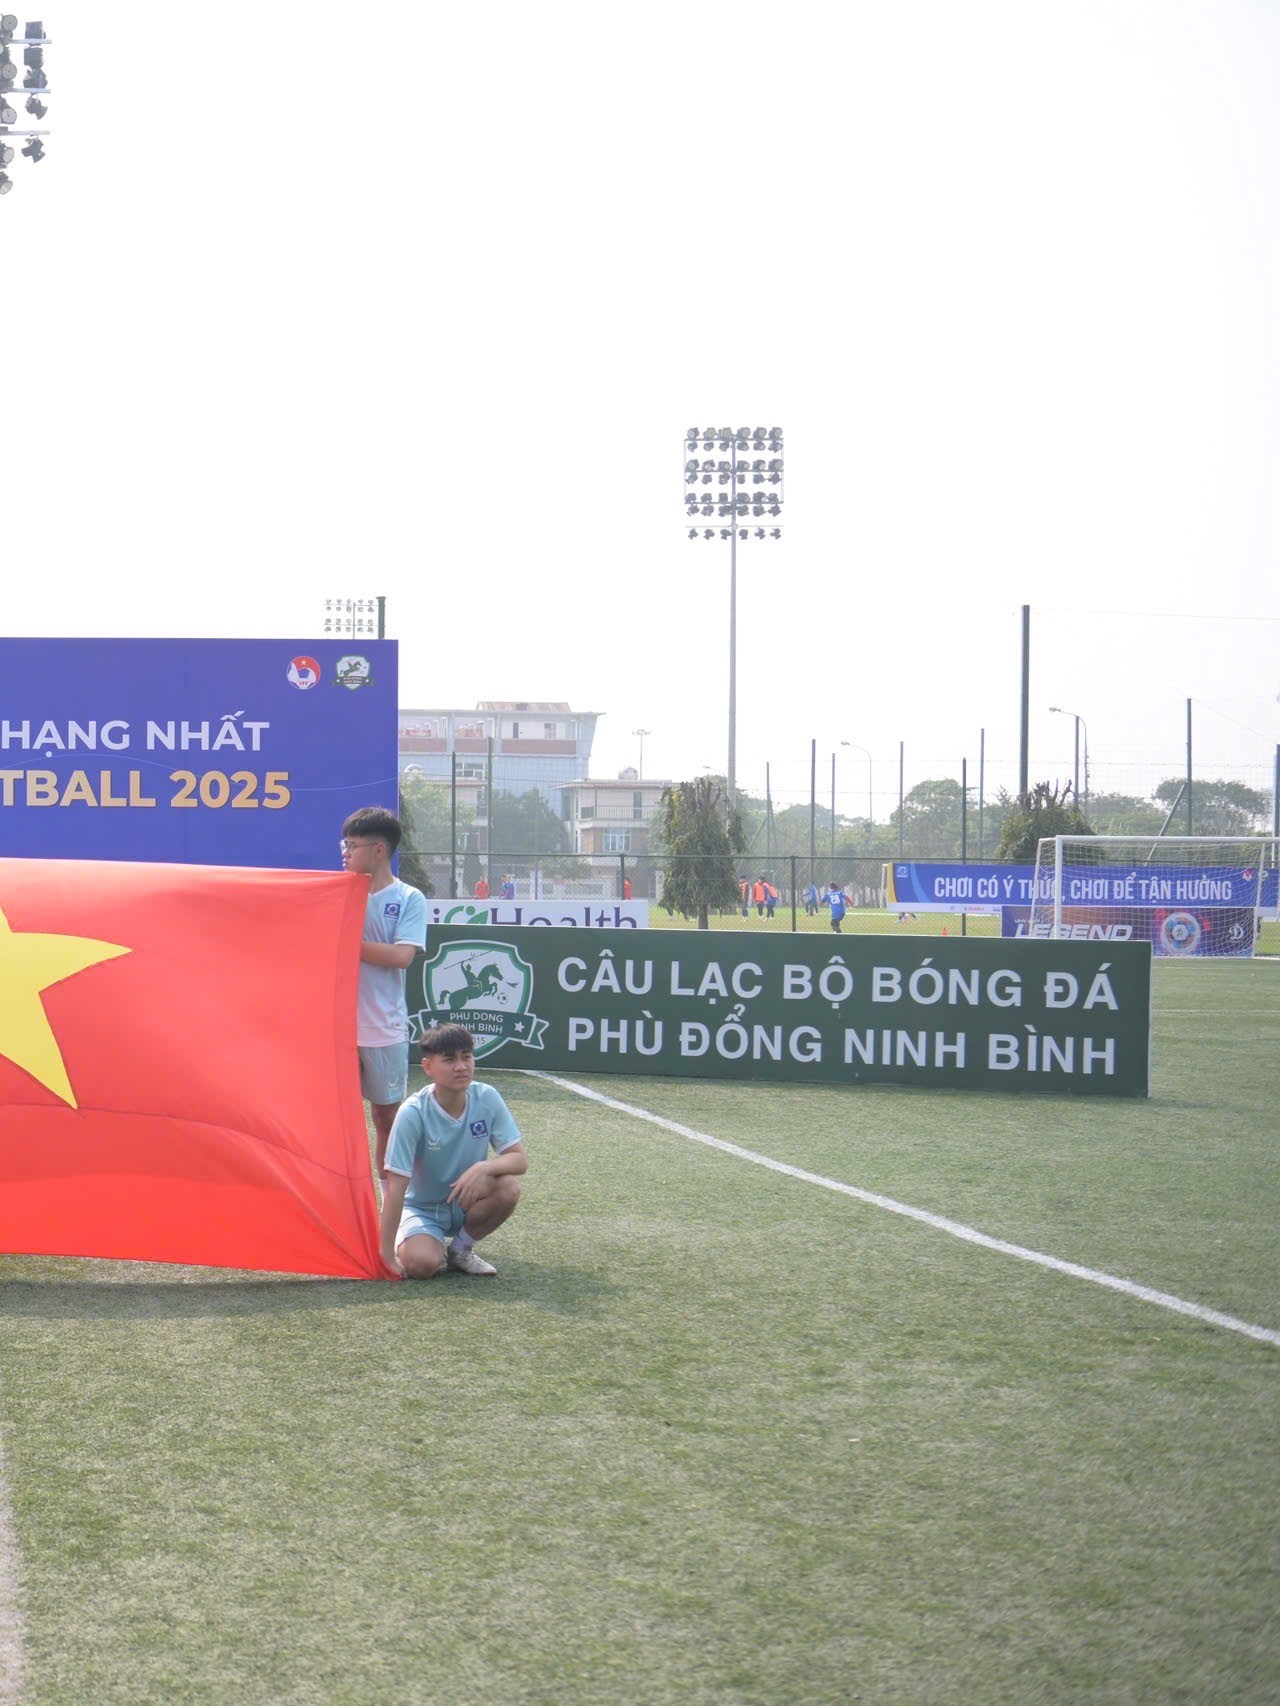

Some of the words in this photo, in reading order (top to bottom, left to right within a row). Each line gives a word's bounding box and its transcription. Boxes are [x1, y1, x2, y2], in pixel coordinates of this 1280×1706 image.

[1, 720, 130, 758] HẠNG
[146, 710, 270, 751] NHẤT
[169, 769, 291, 809] 2025
[934, 876, 973, 898] CHƠI
[977, 874, 998, 899] CÓ
[1000, 874, 1014, 899] Ý
[1070, 879, 1109, 900] CHƠI
[1112, 872, 1136, 900] ĐỂ
[1138, 876, 1171, 903] TẬN
[1176, 874, 1232, 901] HƯỞNG
[557, 948, 653, 995] CÂU
[670, 960, 763, 1005] LẠC
[783, 955, 854, 1010] BỘ
[871, 957, 1022, 1008] BÓNG
[1043, 962, 1119, 1010] ĐÁ
[450, 1012, 470, 1020] PHU
[473, 1012, 503, 1023] DONG
[478, 1023, 503, 1034] BINH
[568, 1010, 663, 1056] PHÙ
[678, 1003, 822, 1063] ĐỔNG
[844, 1028, 965, 1068] NINH
[988, 1024, 1115, 1075] BÌNH
